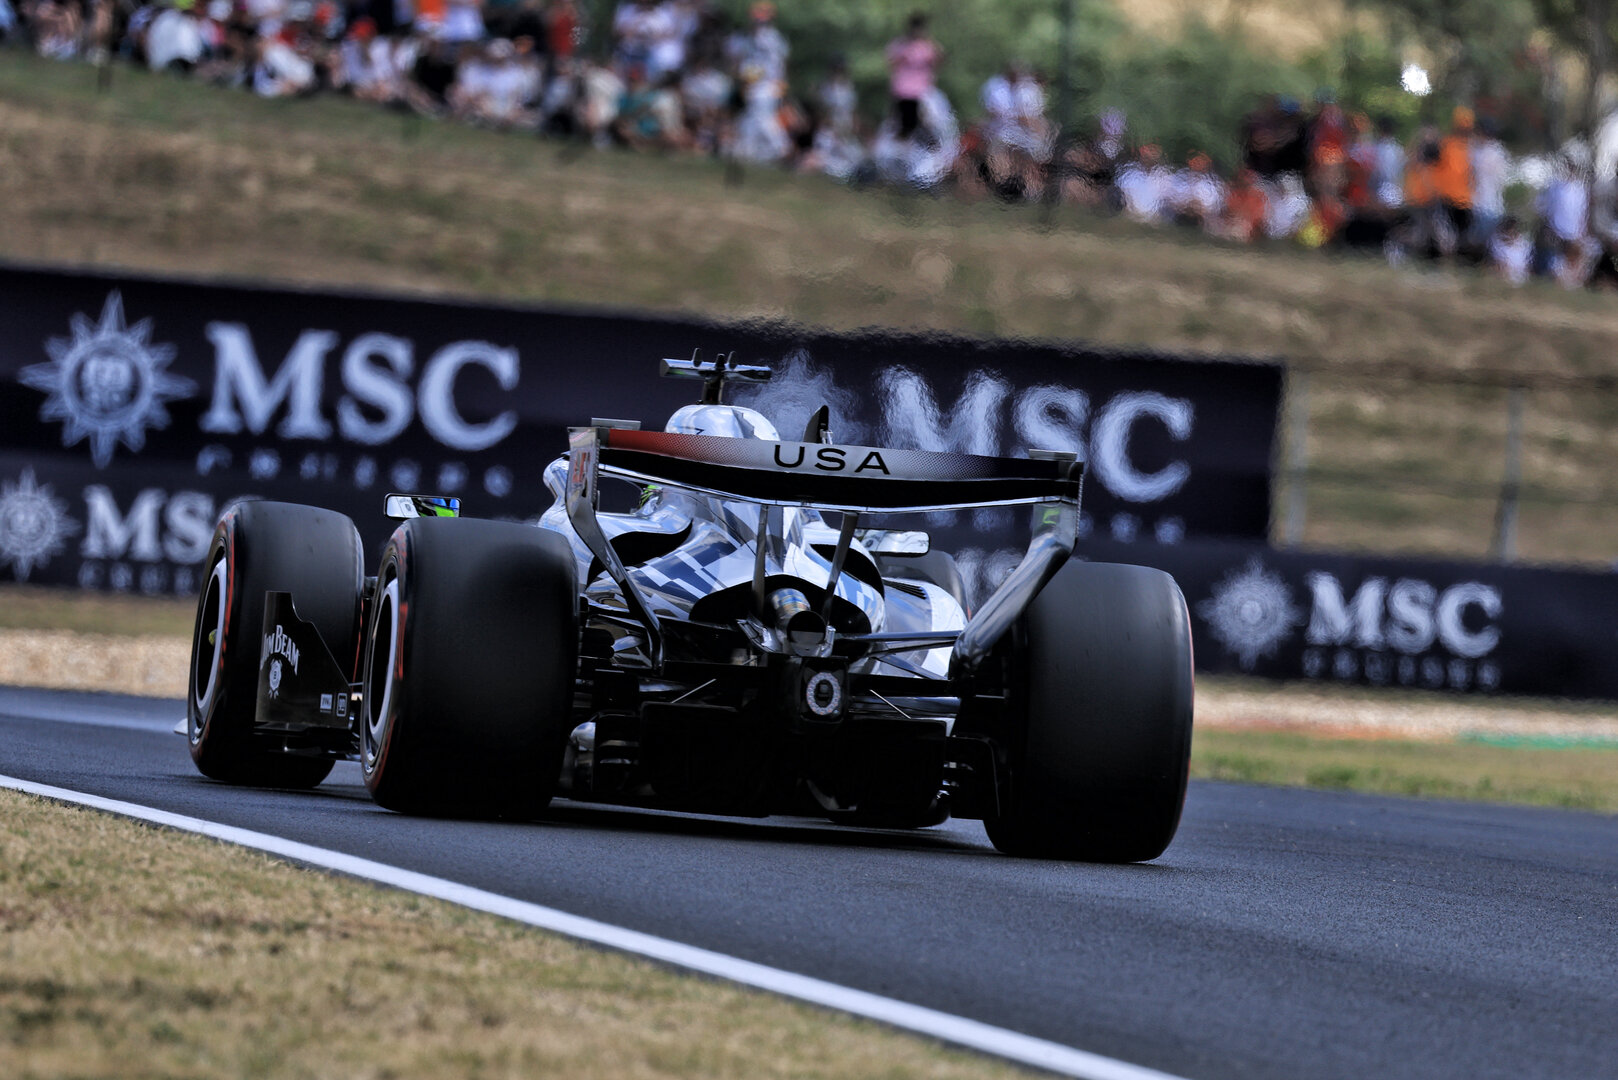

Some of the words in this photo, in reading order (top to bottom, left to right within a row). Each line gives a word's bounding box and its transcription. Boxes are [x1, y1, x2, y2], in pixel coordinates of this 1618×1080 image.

[202, 321, 520, 450] MSC
[774, 444, 890, 475] USA
[871, 365, 1194, 502] MSC
[81, 485, 263, 563] MS
[274, 624, 299, 676] BEAM
[1305, 570, 1502, 658] MSC
